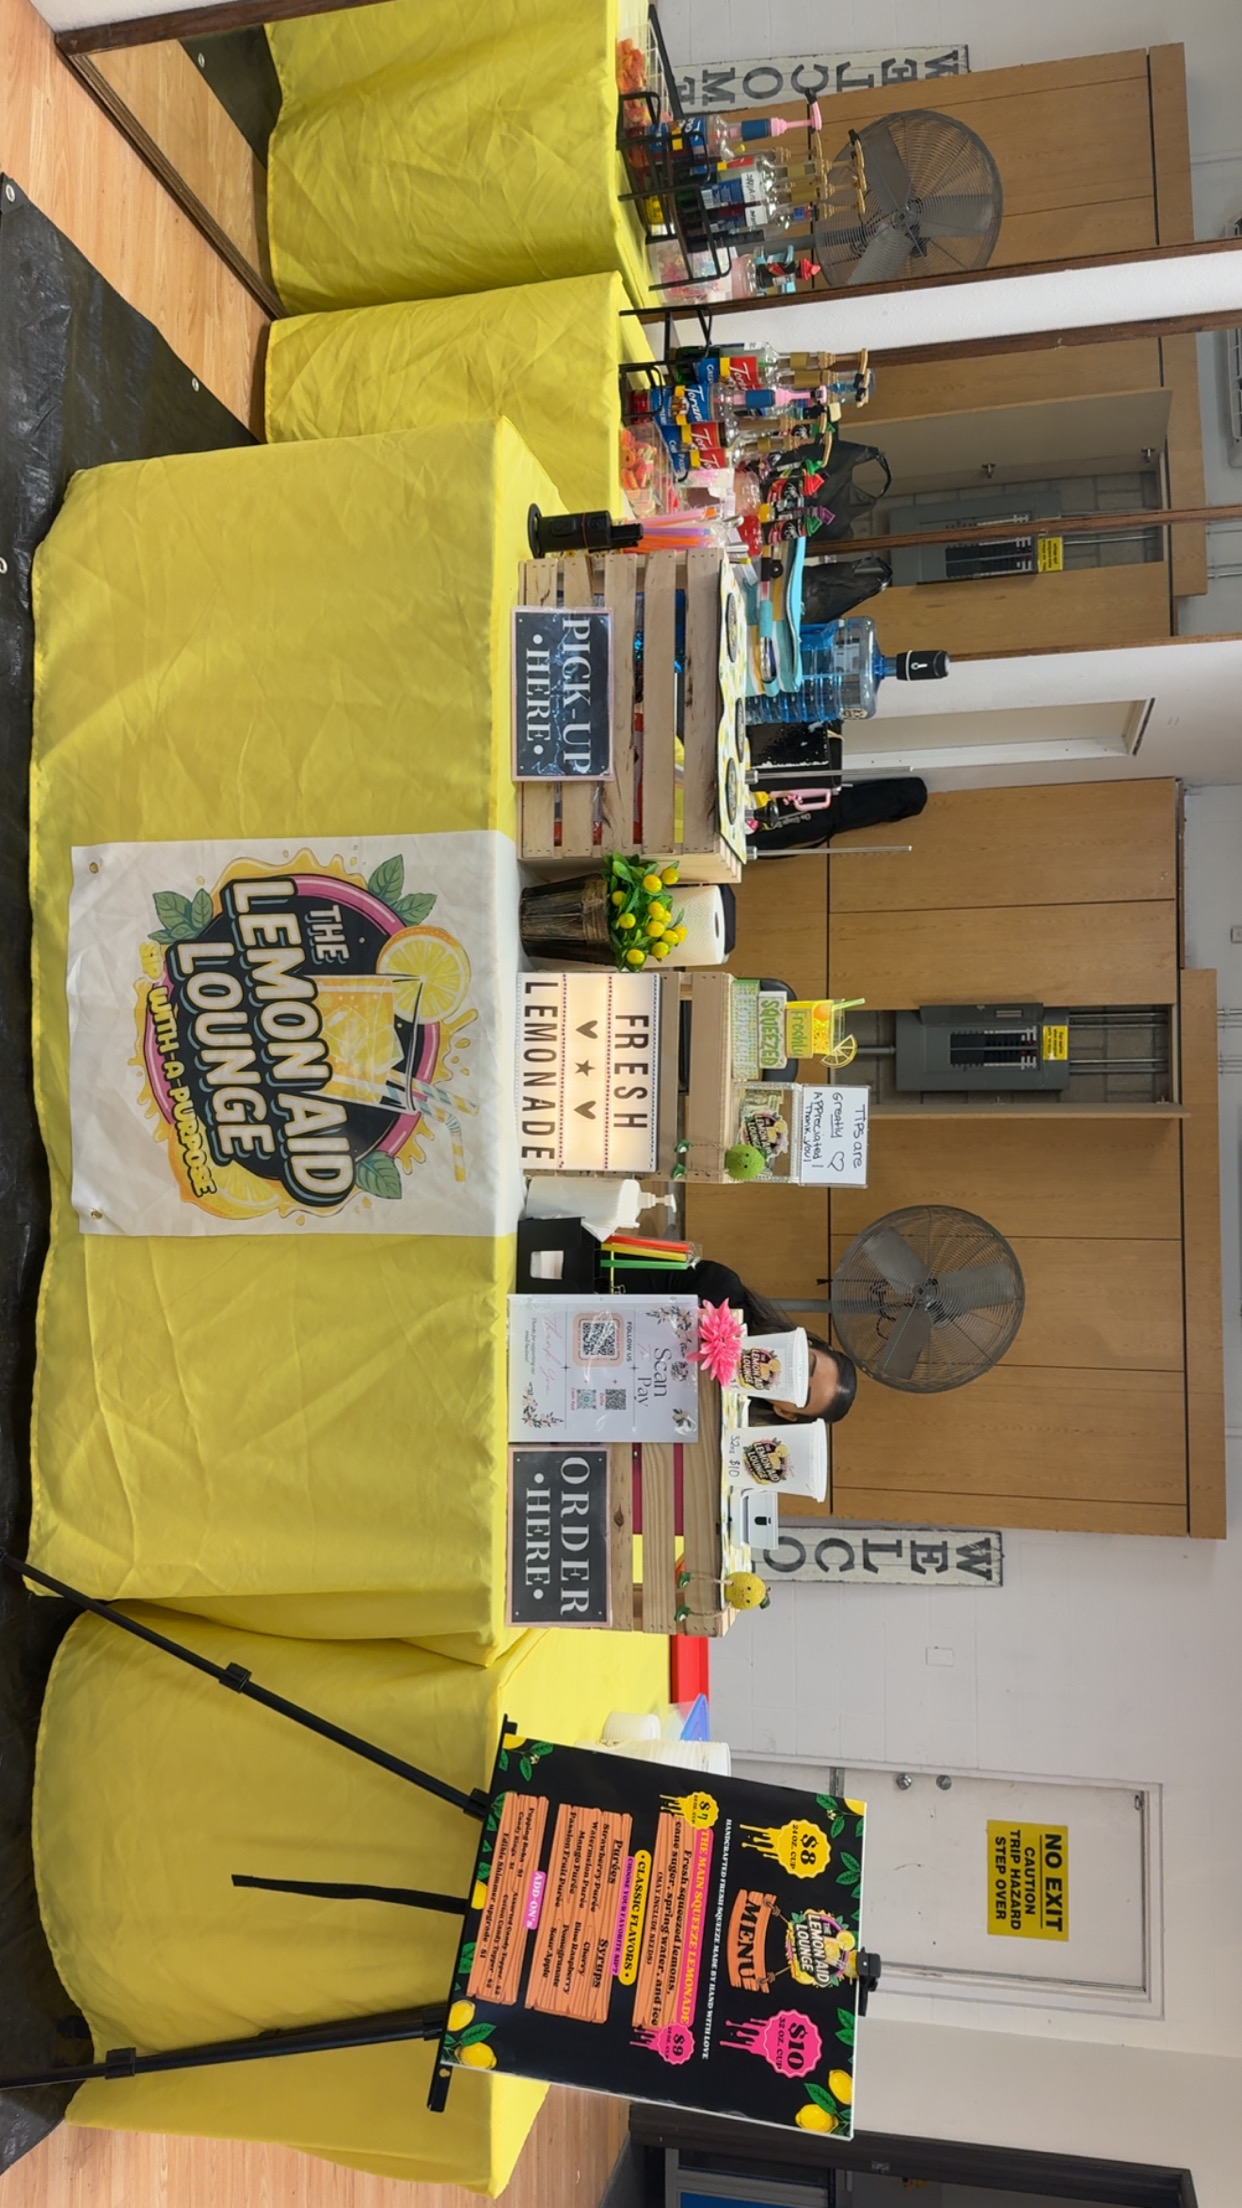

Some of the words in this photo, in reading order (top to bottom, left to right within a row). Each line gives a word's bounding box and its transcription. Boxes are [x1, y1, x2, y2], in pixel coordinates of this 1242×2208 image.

[683, 385, 708, 423] Torani
[562, 617, 591, 774] PICK-UP
[309, 905, 350, 959] THE
[140, 940, 163, 979] SIP
[232, 880, 330, 1081] LEMON
[176, 941, 276, 1155] LOUNGE
[760, 1000, 782, 1066] SQUEEZED
[521, 981, 559, 1160] LEMONADE
[613, 1014, 649, 1129] FRESH
[755, 1115, 768, 1141] LEMON
[804, 1101, 814, 1135] Thank
[831, 1092, 844, 1138] Greatly
[277, 1093, 354, 1196] AID
[853, 1142, 862, 1169] are
[542, 1317, 564, 1365] Thank
[626, 1353, 632, 1362] US
[653, 1347, 672, 1397] Scan
[743, 1355, 752, 1384] LOUNGE
[751, 1350, 761, 1377] LEMON
[539, 1365, 556, 1396] You
[634, 1377, 652, 1408] Pay
[754, 1377, 763, 1389] AID
[728, 1459, 741, 1477] $10
[748, 1451, 768, 1479] LOUNGE
[754, 1444, 772, 1470] LEMON
[767, 1470, 780, 1481] AID
[560, 1457, 591, 1616] ORDER
[752, 1536, 992, 1581] WELCO
[514, 1811, 524, 1835] Candy
[523, 1807, 535, 1841] Popping
[564, 1812, 577, 1849] Passion
[674, 1821, 682, 1849] cane
[498, 1833, 510, 1860] Edible
[511, 1835, 520, 1857] Rings
[519, 1842, 529, 1863] Boba
[574, 1830, 586, 1863] Mango
[583, 1821, 599, 1878] Watermelon
[594, 1823, 610, 1881] Strawberry
[699, 1830, 710, 1855] THE
[720, 1818, 732, 1878] HANDCRAFTED
[800, 1834, 819, 1865] $8
[995, 1836, 1007, 1875] STEP
[1010, 1829, 1021, 1864] TRIP
[1045, 1834, 1063, 1869] NO
[517, 1869, 524, 1878] $1
[559, 1850, 571, 1876] Fruit
[608, 1840, 623, 1885] Purées
[624, 1857, 634, 1889] CHOOSE
[681, 1850, 692, 1884] Fresh
[695, 1856, 707, 1889] MAIN
[490, 1861, 504, 1903] Shimmer
[555, 1877, 566, 1908] Purée
[569, 1865, 581, 1894] Purée
[579, 1880, 590, 1909] Purée
[632, 1861, 646, 1913] CLASSIC
[655, 1871, 664, 1894] (MAY
[717, 1878, 726, 1905] FRESH
[1024, 1847, 1036, 1915] CAUTION
[499, 1894, 509, 1919] Cotton
[507, 1891, 519, 1925] Assorted
[590, 1882, 601, 1913] Purée
[621, 1891, 629, 1912] YOUR
[650, 1895, 661, 1932] INCLUDE
[661, 1891, 675, 1934] spring
[995, 1879, 1007, 1920] OVER
[1010, 1868, 1021, 1930] HAZARD
[1045, 1877, 1063, 1932] EXIT
[483, 1904, 495, 1942] upgrade
[674, 1886, 687, 1943] squeezed
[689, 1891, 704, 1950] SQUEEZE
[714, 1906, 723, 1945] SQUEEZE
[823, 1923, 831, 1935] THE
[494, 1920, 504, 1943] Candy
[502, 1926, 514, 1950] Candy
[548, 1927, 557, 1950] Sour
[572, 1921, 582, 1942] Blue
[615, 1912, 625, 1953] FAVORITE
[623, 1914, 638, 1970] FLAVORS
[737, 1900, 762, 1980] MENU
[795, 1924, 814, 1972] LOUNGE
[807, 1914, 825, 1958] LEMON
[489, 1945, 499, 1972] Topper
[542, 1951, 553, 1978] Apple
[553, 1924, 570, 1988] Pomegranate
[578, 1942, 591, 1977] Cherry
[592, 1938, 609, 1988] Syrups
[612, 1953, 620, 1974] SIP?
[646, 1933, 656, 1965] SEEDS)
[711, 1945, 719, 1969] MADE
[497, 1952, 508, 1980] Topper
[563, 1943, 578, 1995] Raspberry
[666, 1945, 682, 1995] lemons,
[710, 1970, 717, 1983] BY
[814, 1959, 830, 1983] AID
[653, 1979, 665, 2004] and
[680, 1951, 696, 2024] LEMONADE
[707, 1983, 716, 2009] HAND
[651, 2007, 662, 2027] ice
[704, 2010, 713, 2035] WITH
[779, 2017, 786, 2029] 32
[672, 2033, 686, 2057] $9
[702, 2035, 711, 2060] LOVE
[777, 2030, 785, 2046] OZ.
[787, 2022, 808, 2070] $10
[775, 2048, 783, 2070] CUP
